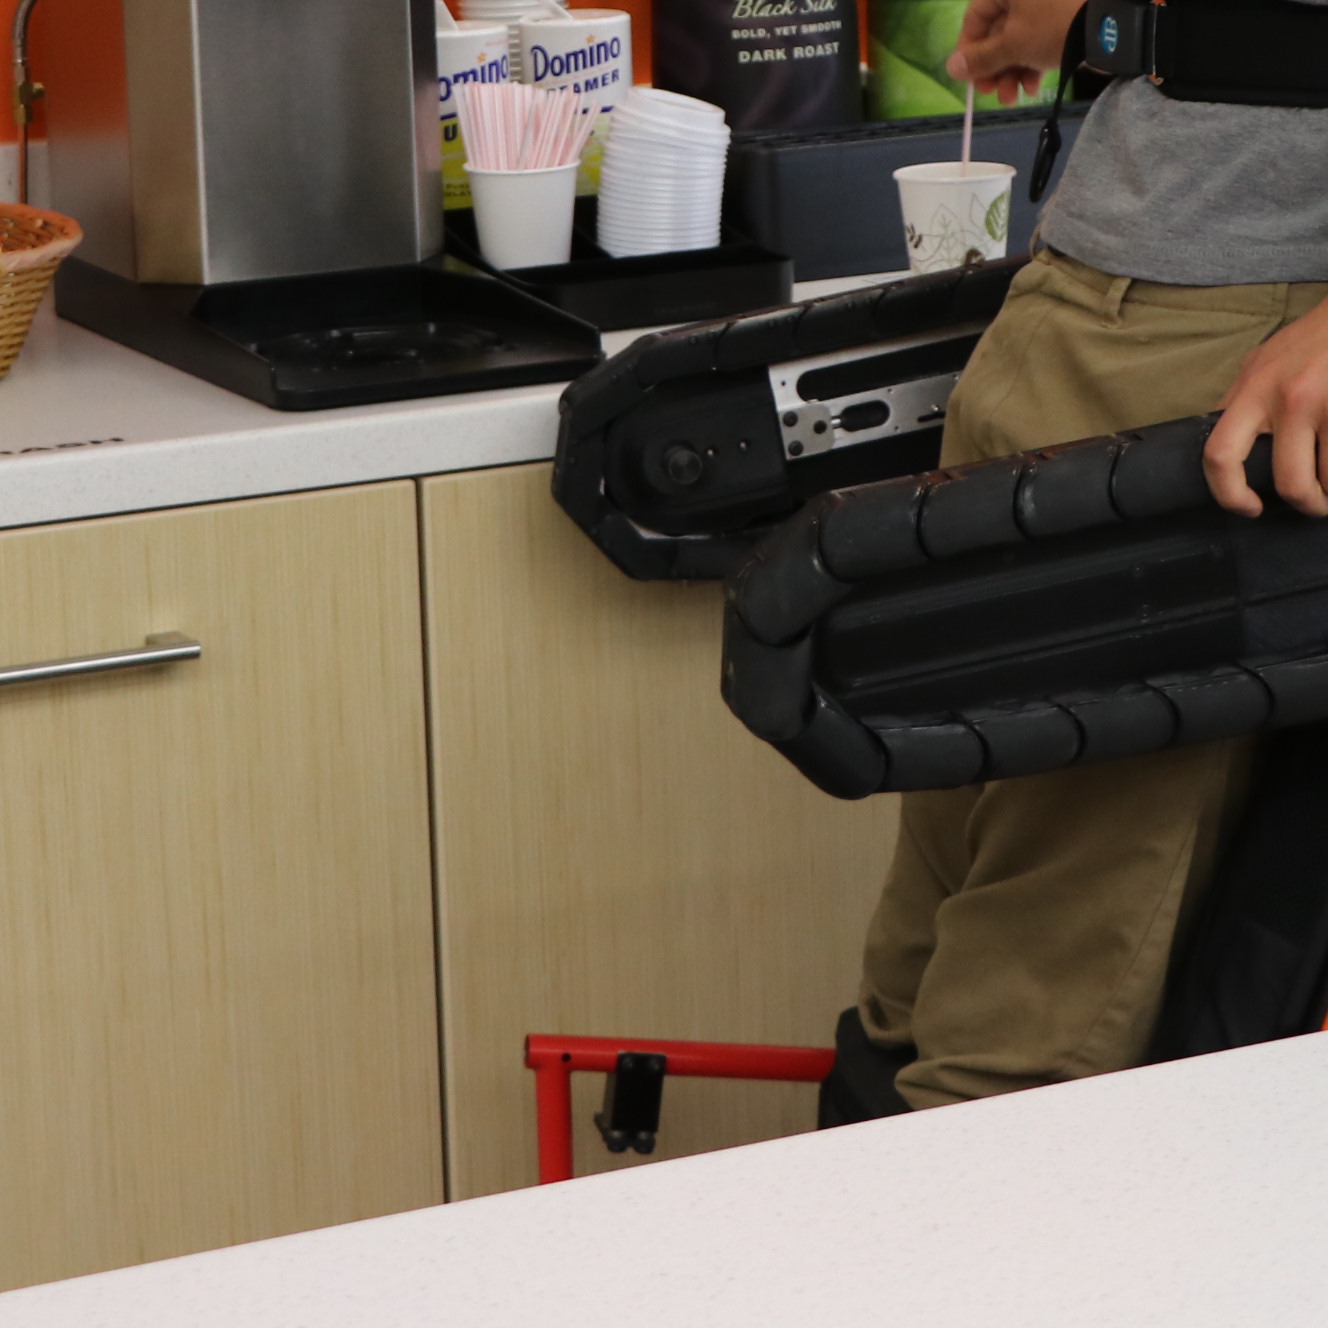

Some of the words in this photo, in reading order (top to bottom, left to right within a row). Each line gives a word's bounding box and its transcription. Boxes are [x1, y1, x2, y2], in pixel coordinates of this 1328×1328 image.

[775, 25, 798, 35] YET
[802, 20, 842, 33] SMOOTH
[531, 37, 620, 82] Domino
[738, 48, 787, 63] DARK
[793, 42, 840, 59] ROAST
[439, 54, 508, 102] omino
